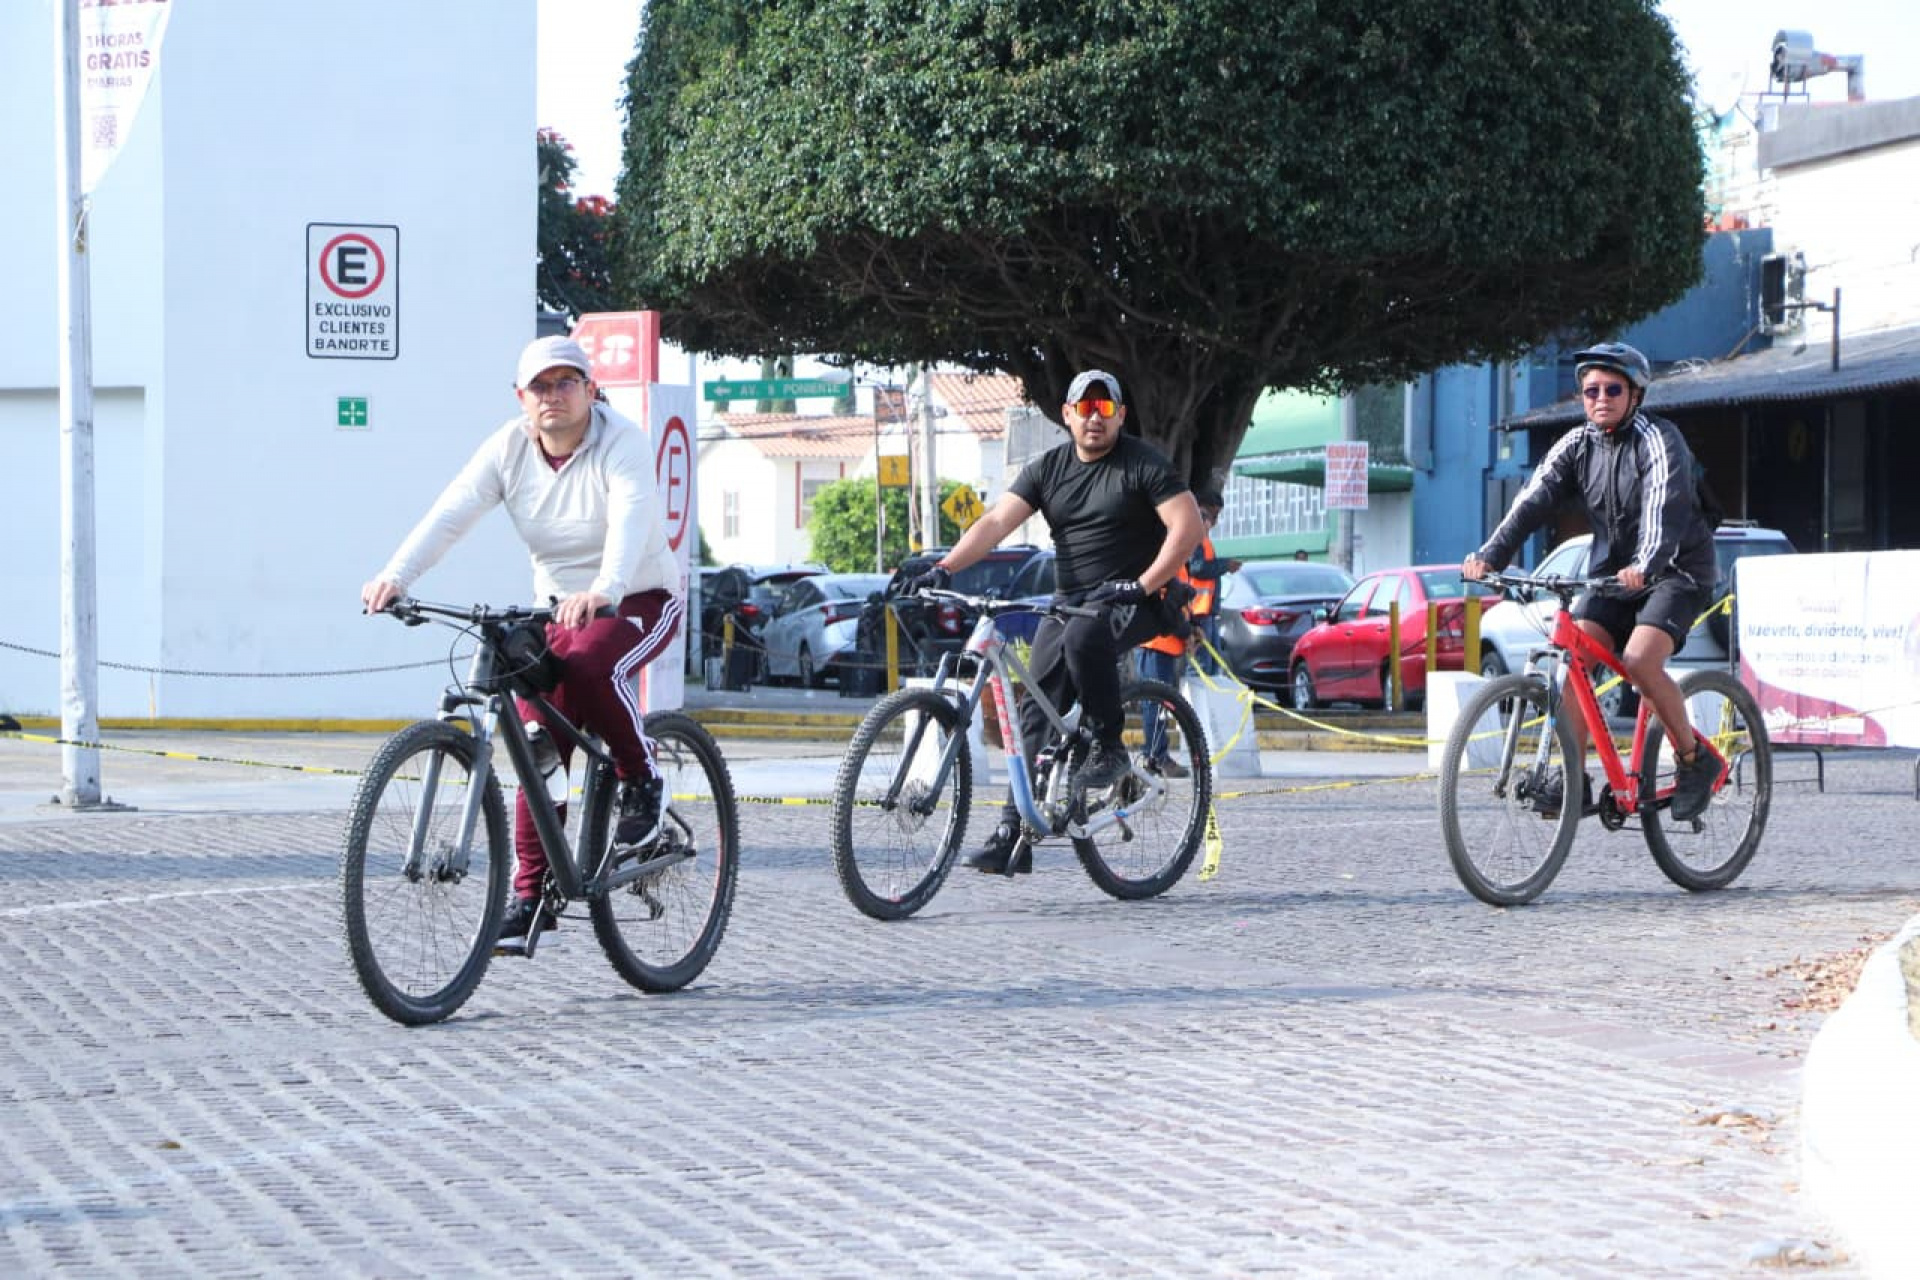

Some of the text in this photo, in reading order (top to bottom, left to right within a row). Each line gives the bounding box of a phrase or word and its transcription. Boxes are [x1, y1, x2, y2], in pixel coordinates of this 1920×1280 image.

[86, 50, 151, 70] GRATIS
[337, 246, 367, 285] E
[315, 303, 391, 317] EXCLUSIVO
[319, 320, 385, 334] CLIENTES
[315, 338, 390, 351] BANORTE
